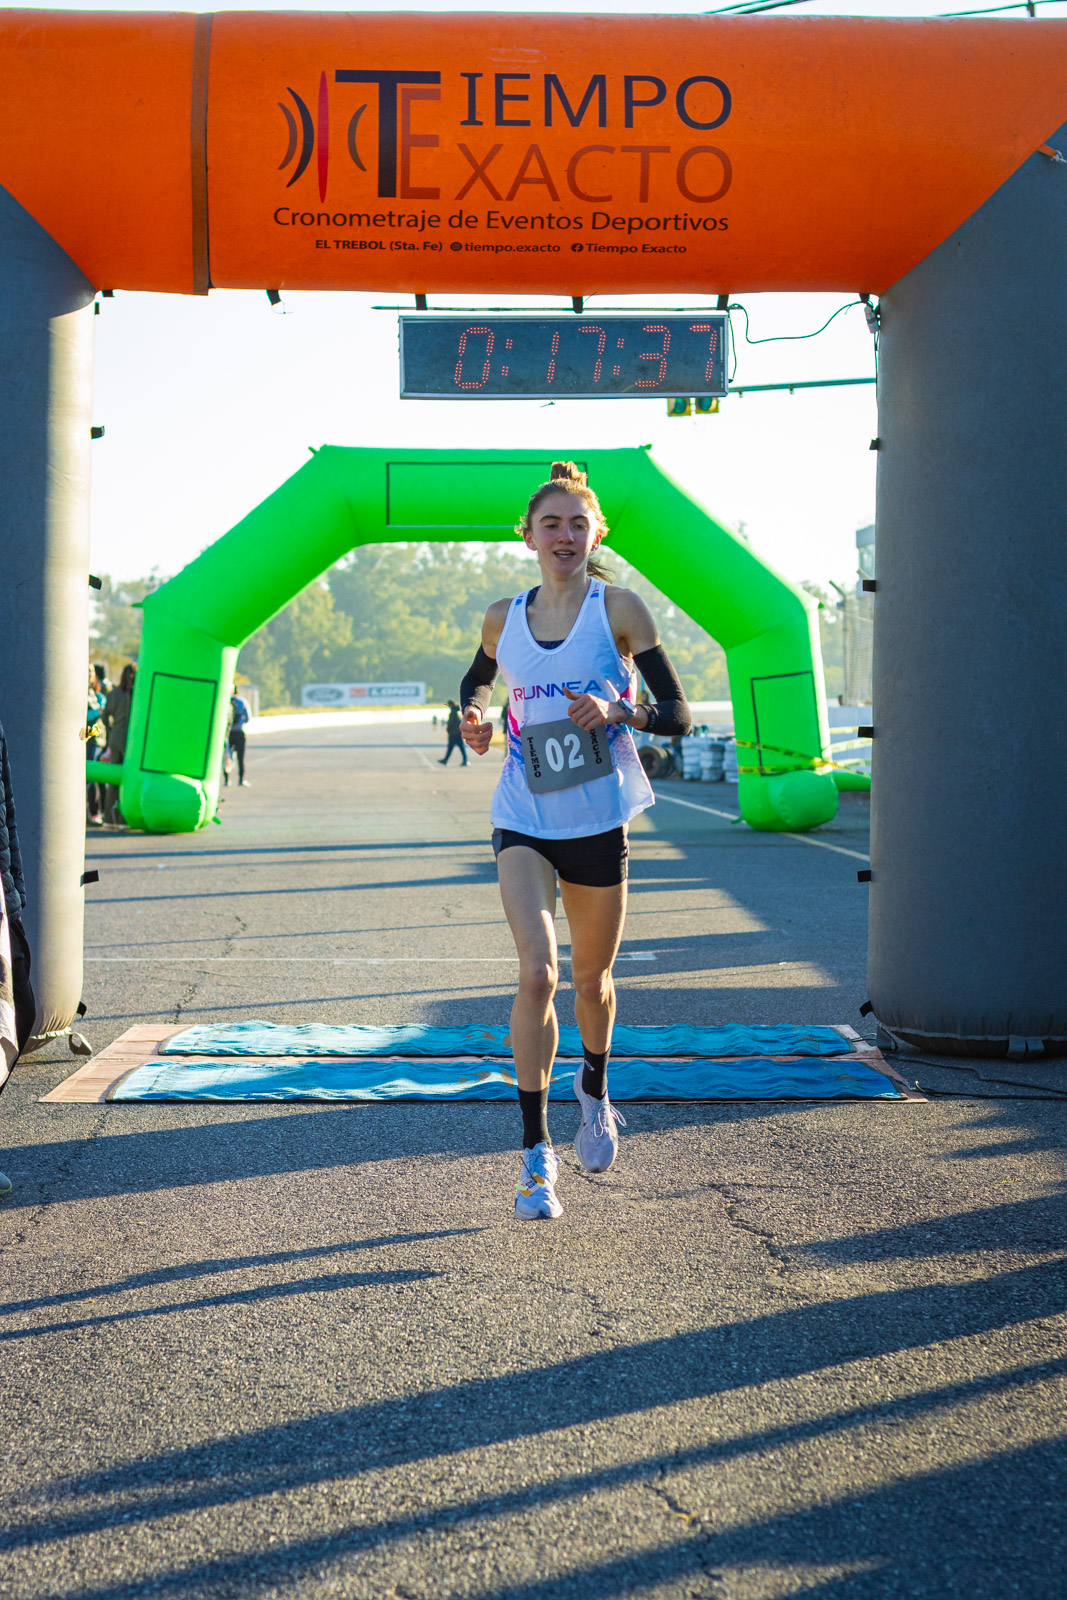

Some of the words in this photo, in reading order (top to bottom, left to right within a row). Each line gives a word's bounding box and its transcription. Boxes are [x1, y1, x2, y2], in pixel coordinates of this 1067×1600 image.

[273, 207, 441, 232] Cronometraje
[448, 210, 479, 229] de
[487, 211, 584, 230] Eventos
[591, 212, 729, 235] Deportivos
[315, 240, 331, 249] EL
[333, 240, 387, 250] TREBOL
[389, 241, 420, 252] (Sta.
[423, 241, 443, 252] Fe)
[464, 242, 561, 254] tiempo.exacto
[585, 243, 639, 255] Tiempo
[641, 243, 687, 254] Exacto
[512, 679, 602, 702] RUNNEA
[526, 736, 542, 778] TIEMPO
[545, 733, 586, 773] 02
